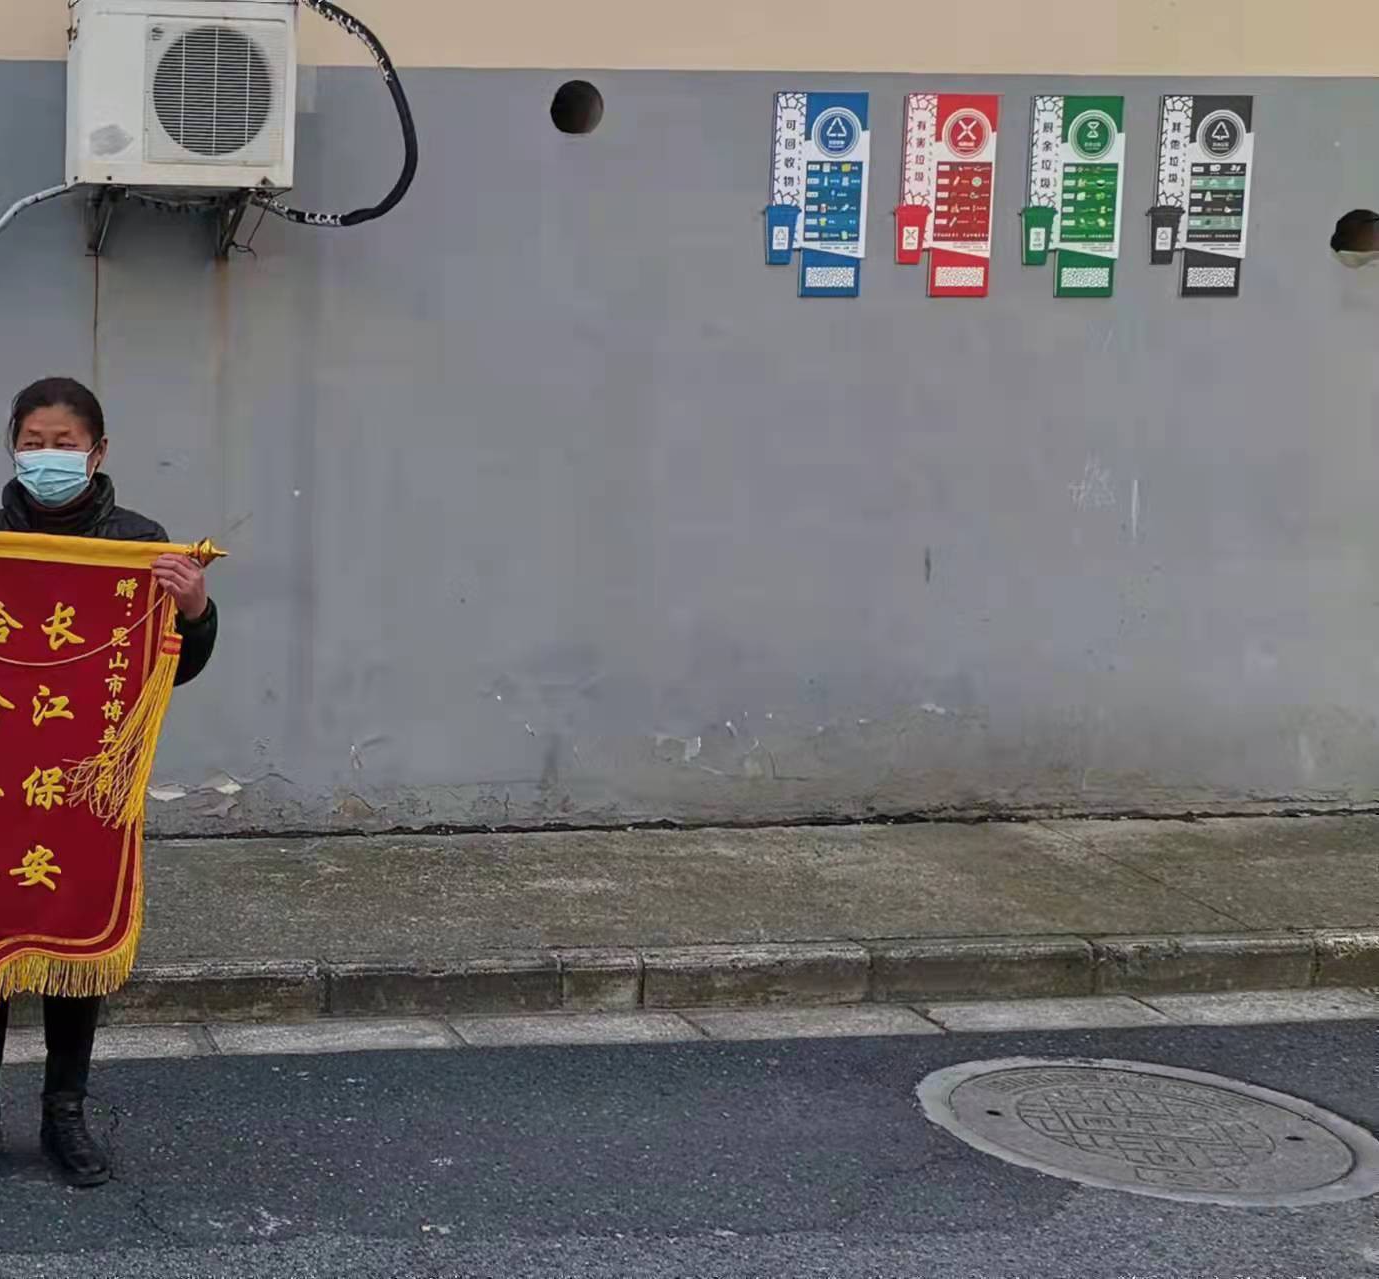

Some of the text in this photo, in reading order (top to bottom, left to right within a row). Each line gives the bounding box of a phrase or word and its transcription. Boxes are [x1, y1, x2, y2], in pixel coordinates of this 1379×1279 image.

[783, 119, 796, 187] 可回收物
[914, 120, 926, 182] 有害垃圾
[1039, 122, 1054, 188] 厨余垃圾
[1168, 121, 1181, 183] 其他垃圾
[9, 602, 85, 890] 长江保安
